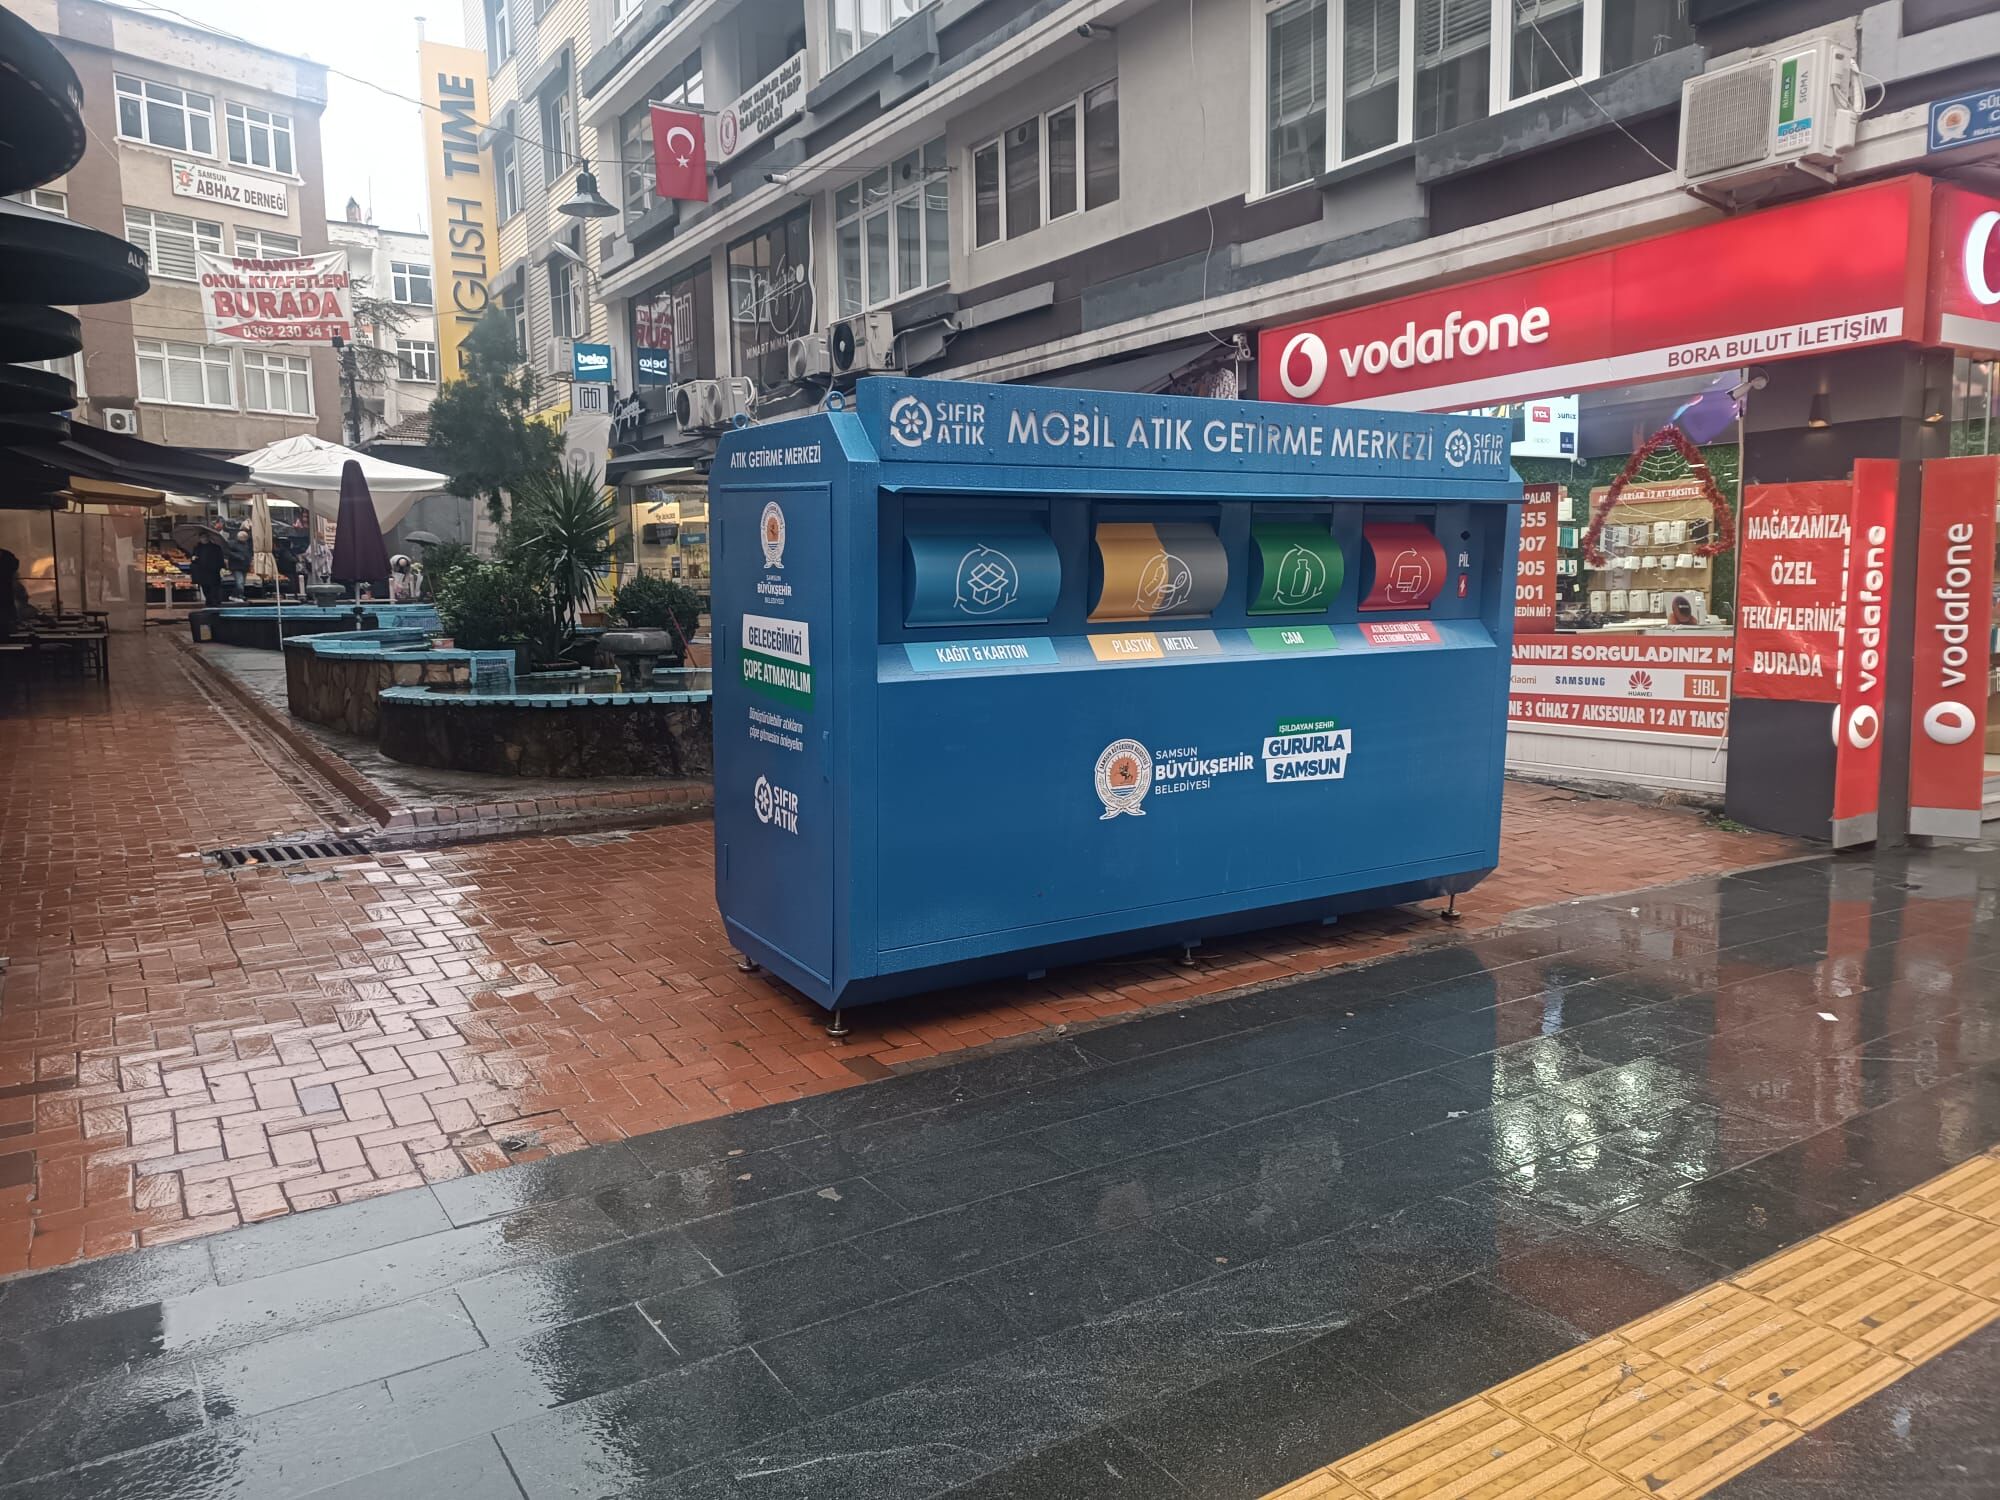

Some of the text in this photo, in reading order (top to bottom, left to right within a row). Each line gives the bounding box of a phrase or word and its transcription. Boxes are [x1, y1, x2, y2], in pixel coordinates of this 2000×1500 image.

[1799, 70, 1809, 104] SIGMA
[739, 95, 774, 132] SAMSUN
[438, 73, 480, 178] TIME
[198, 169, 227, 182] SAMSUN
[196, 180, 287, 212] ABHAZ DERNEĞİ
[232, 257, 316, 272] PARANTEZ
[201, 271, 349, 289] OKUL KIYAFETLERİ
[213, 291, 344, 319] BURADA
[242, 325, 273, 338] 0362
[279, 325, 300, 338] 230
[306, 325, 322, 338] 34
[1339, 306, 1550, 378] vodafone
[1668, 315, 1888, 368] BORA BULUT İLETİŞİM
[577, 352, 609, 365] beko
[936, 402, 984, 423] SIFIR
[1534, 410, 1549, 418] TCL
[936, 424, 985, 446] ATIK
[1007, 406, 1433, 462] MOBİL ATIK GETİRME MERKEZİ
[1473, 432, 1504, 450] SIFIR
[730, 440, 821, 469] ATIK GETİRME MERKEZİ
[1473, 449, 1503, 465] ATIK
[1748, 508, 1849, 540] MAĞAZAMIZA
[1458, 551, 1470, 568] PİL
[1771, 555, 1817, 585] ÖZEL
[757, 581, 792, 597] BÜYÜKŞEHİR
[1857, 525, 1887, 693] vodafone
[1935, 522, 1974, 688] vodafone
[748, 626, 802, 656] GELECEĞİMİZİ
[1111, 636, 1154, 653] PLASTİK
[1163, 636, 1198, 652] METAL
[1281, 631, 1305, 645] CAM
[936, 644, 1030, 663] KAĞIT & KARTON
[1571, 645, 1713, 664] SORGULADINIZ
[1753, 650, 1823, 678] BURADA
[763, 663, 811, 694] ATMAYALIM
[1555, 675, 1606, 687] SAMSUNG
[1692, 679, 1720, 697] JBL
[1525, 701, 1533, 717] 3
[1535, 697, 1569, 719] CİHAZ
[1571, 703, 1580, 720] 7
[1582, 704, 1645, 724] AKSESUAR
[1649, 708, 1666, 725] 12
[1668, 709, 1687, 727] AY
[1279, 722, 1314, 734] IŞILDAYAN
[1155, 746, 1198, 760] SAMSUN
[1268, 734, 1346, 757] GURURLA
[1155, 751, 1255, 781] BÜYÜKŞEHİR
[1273, 757, 1341, 780] SAMSUN
[1154, 777, 1211, 795] BELEDİYESİ
[773, 785, 799, 814] SIFIR
[773, 806, 799, 836] ATIK
